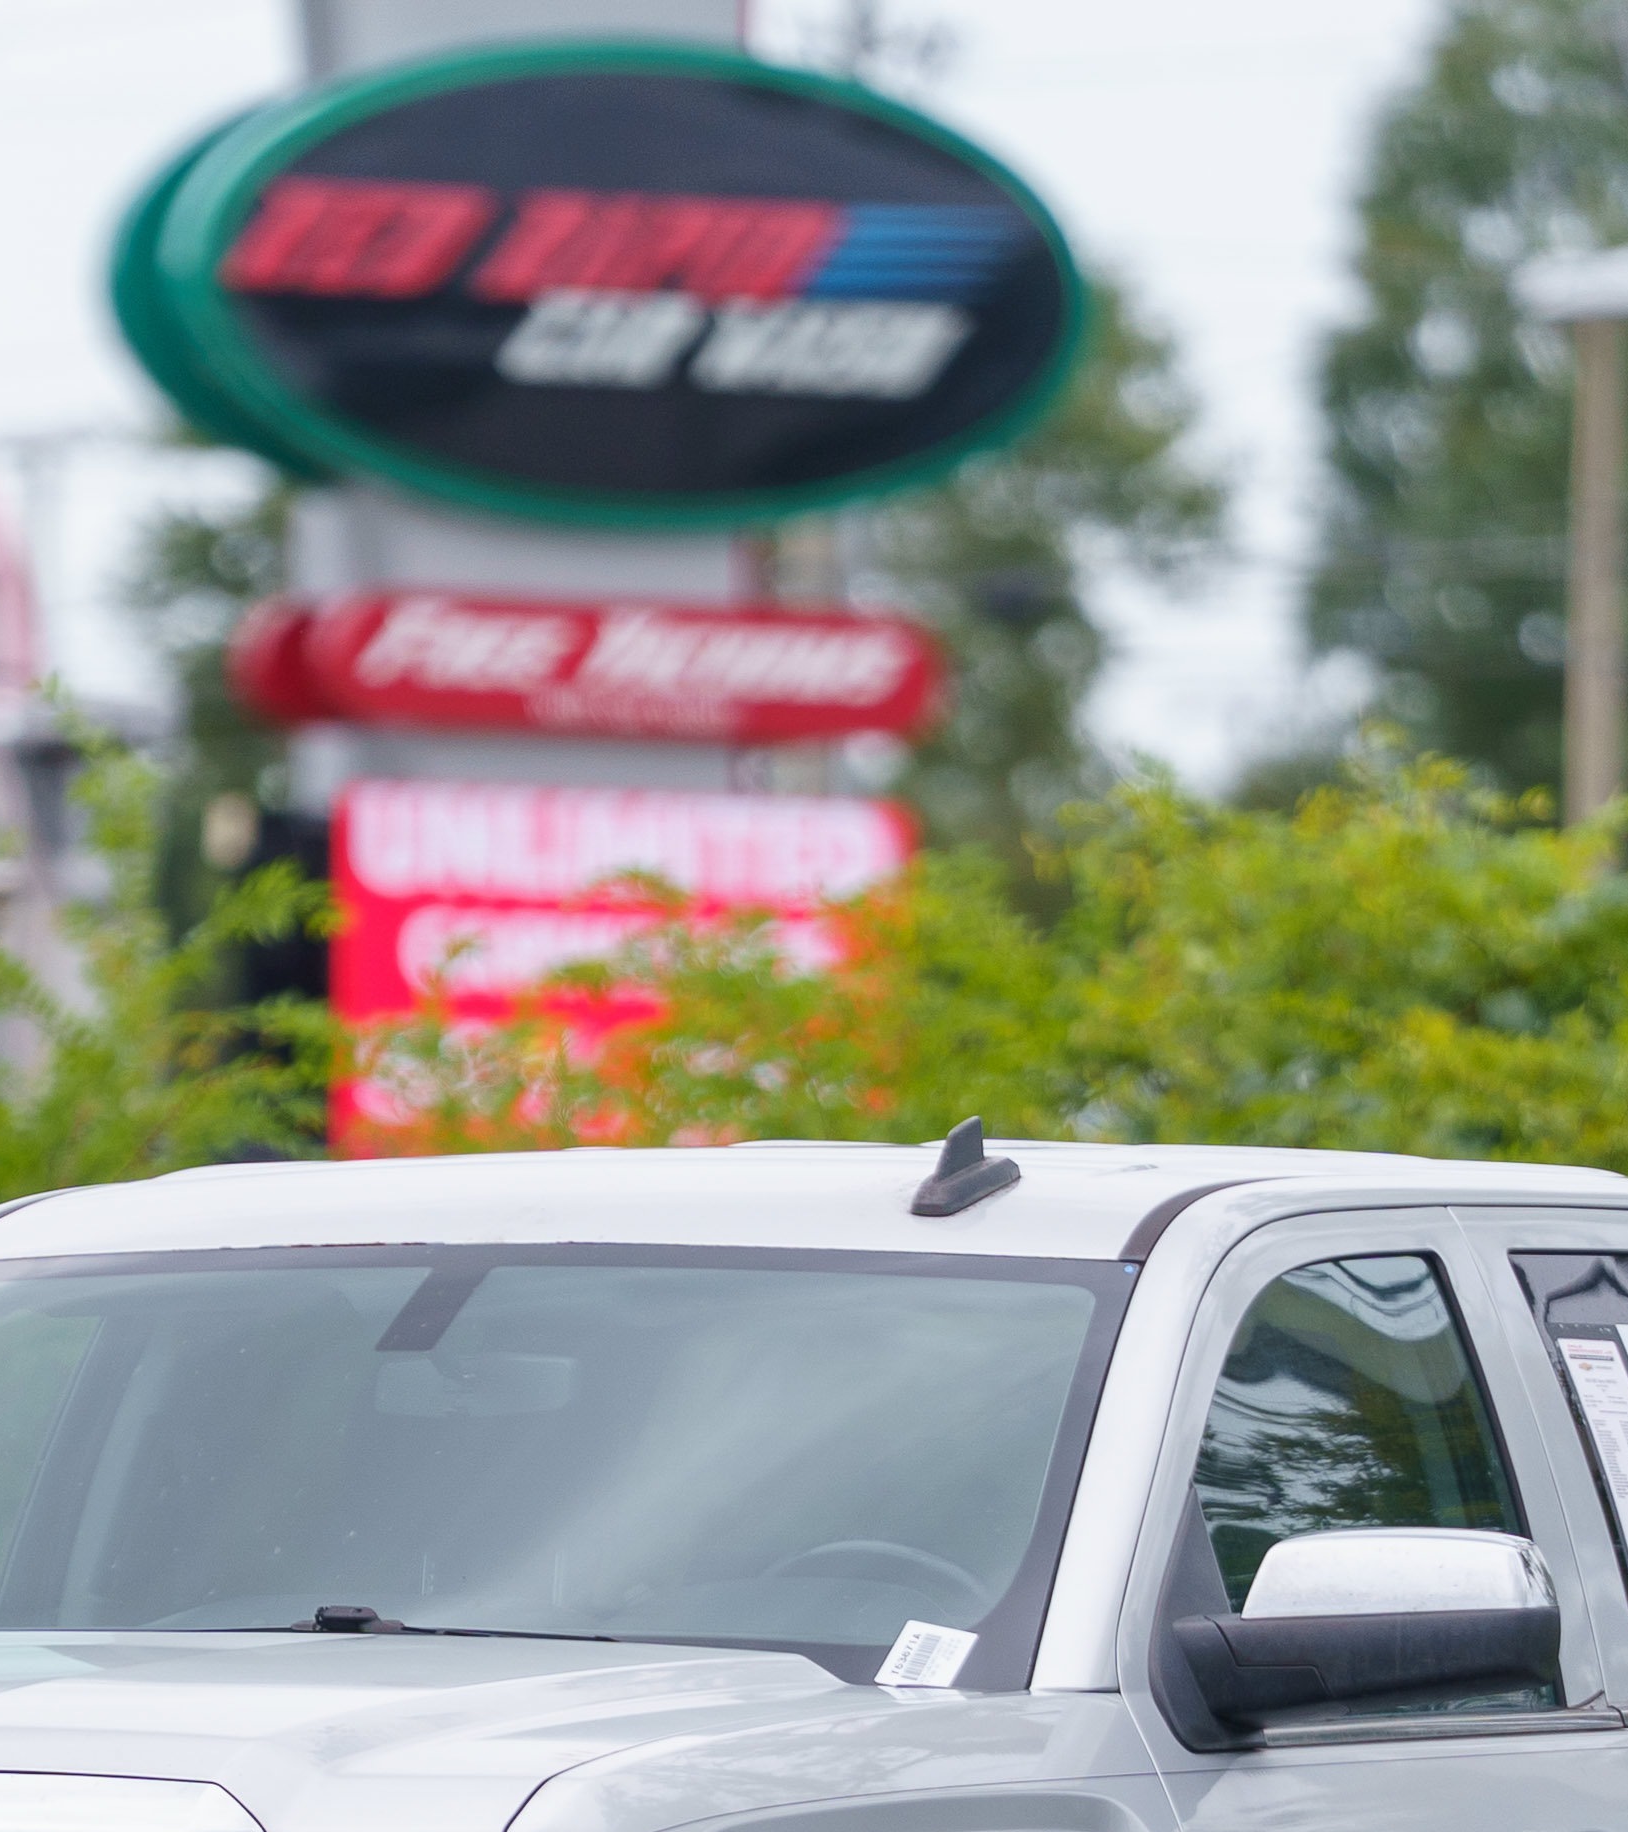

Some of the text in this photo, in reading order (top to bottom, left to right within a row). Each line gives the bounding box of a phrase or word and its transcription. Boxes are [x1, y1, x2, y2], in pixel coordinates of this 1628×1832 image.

[219, 174, 497, 297] RED
[497, 288, 971, 400] CAR WASH
[345, 784, 909, 900] UNLIMITED
